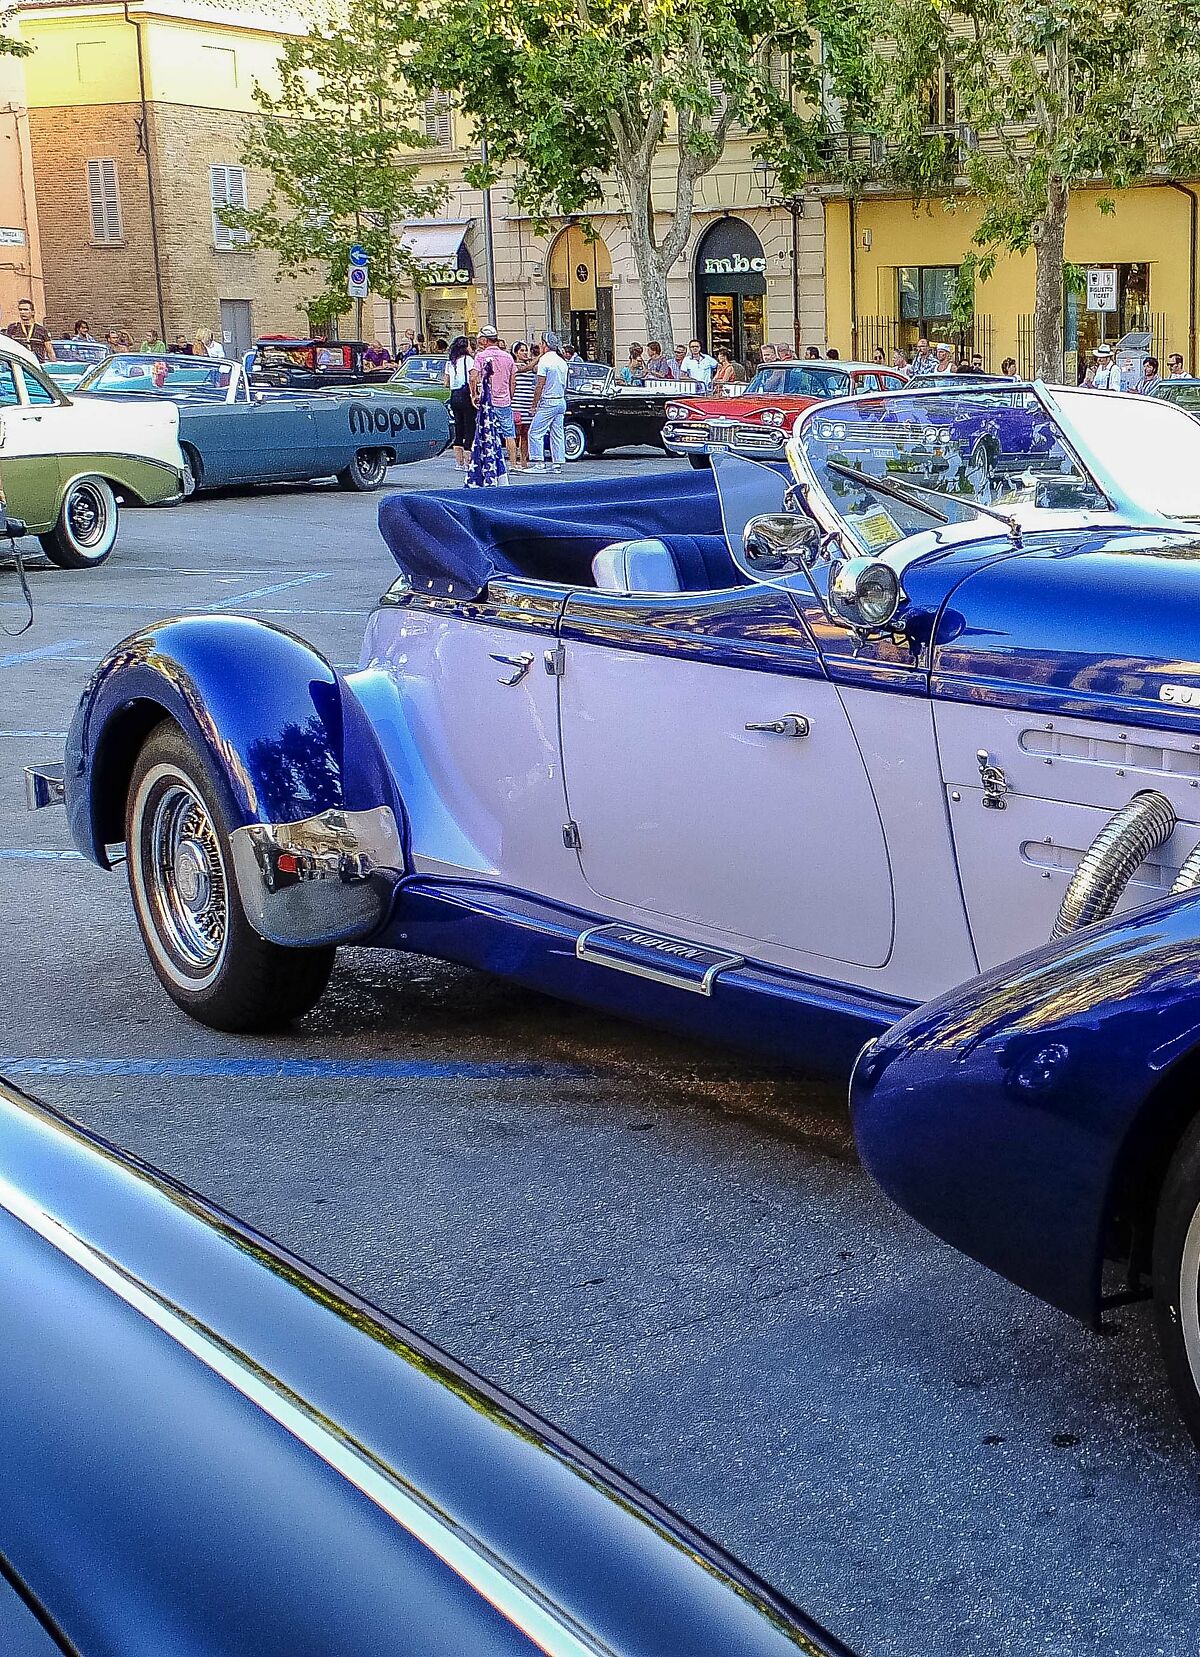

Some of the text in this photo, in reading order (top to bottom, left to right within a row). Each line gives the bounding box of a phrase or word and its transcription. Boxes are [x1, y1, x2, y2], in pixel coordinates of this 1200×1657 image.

[704, 253, 766, 273] mbc
[348, 403, 428, 438] mopar
[618, 933, 706, 959] AUBURN
